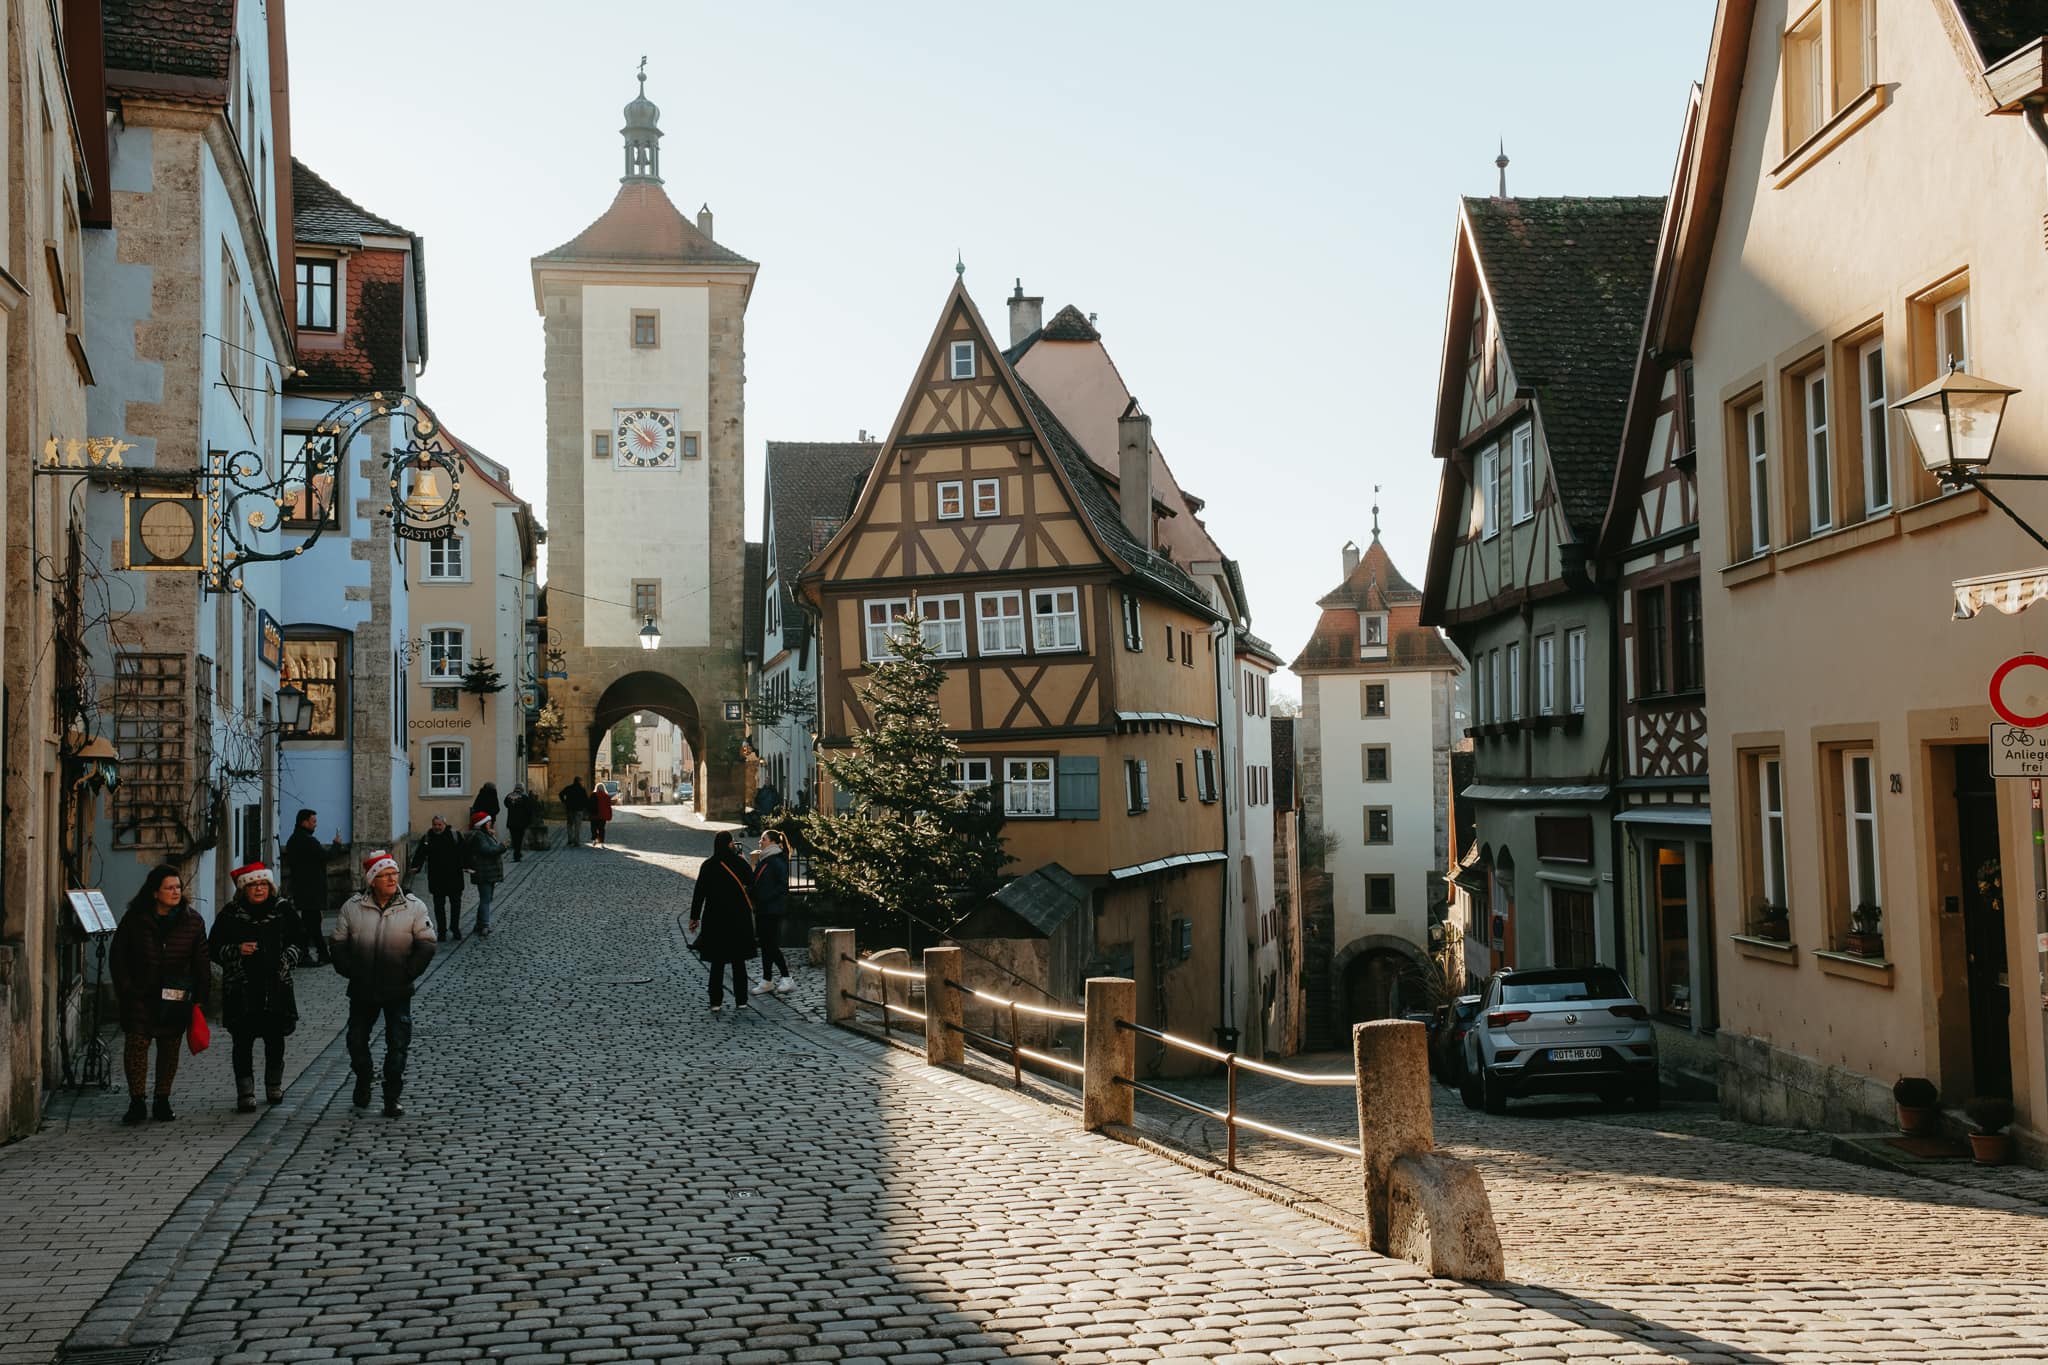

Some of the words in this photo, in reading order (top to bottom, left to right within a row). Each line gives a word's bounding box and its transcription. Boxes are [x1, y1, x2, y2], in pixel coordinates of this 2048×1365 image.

[400, 526, 450, 539] GASTHOF
[2022, 762, 2042, 772] frei
[1574, 1049, 1584, 1058] HB
[1586, 1049, 1601, 1057] 600
